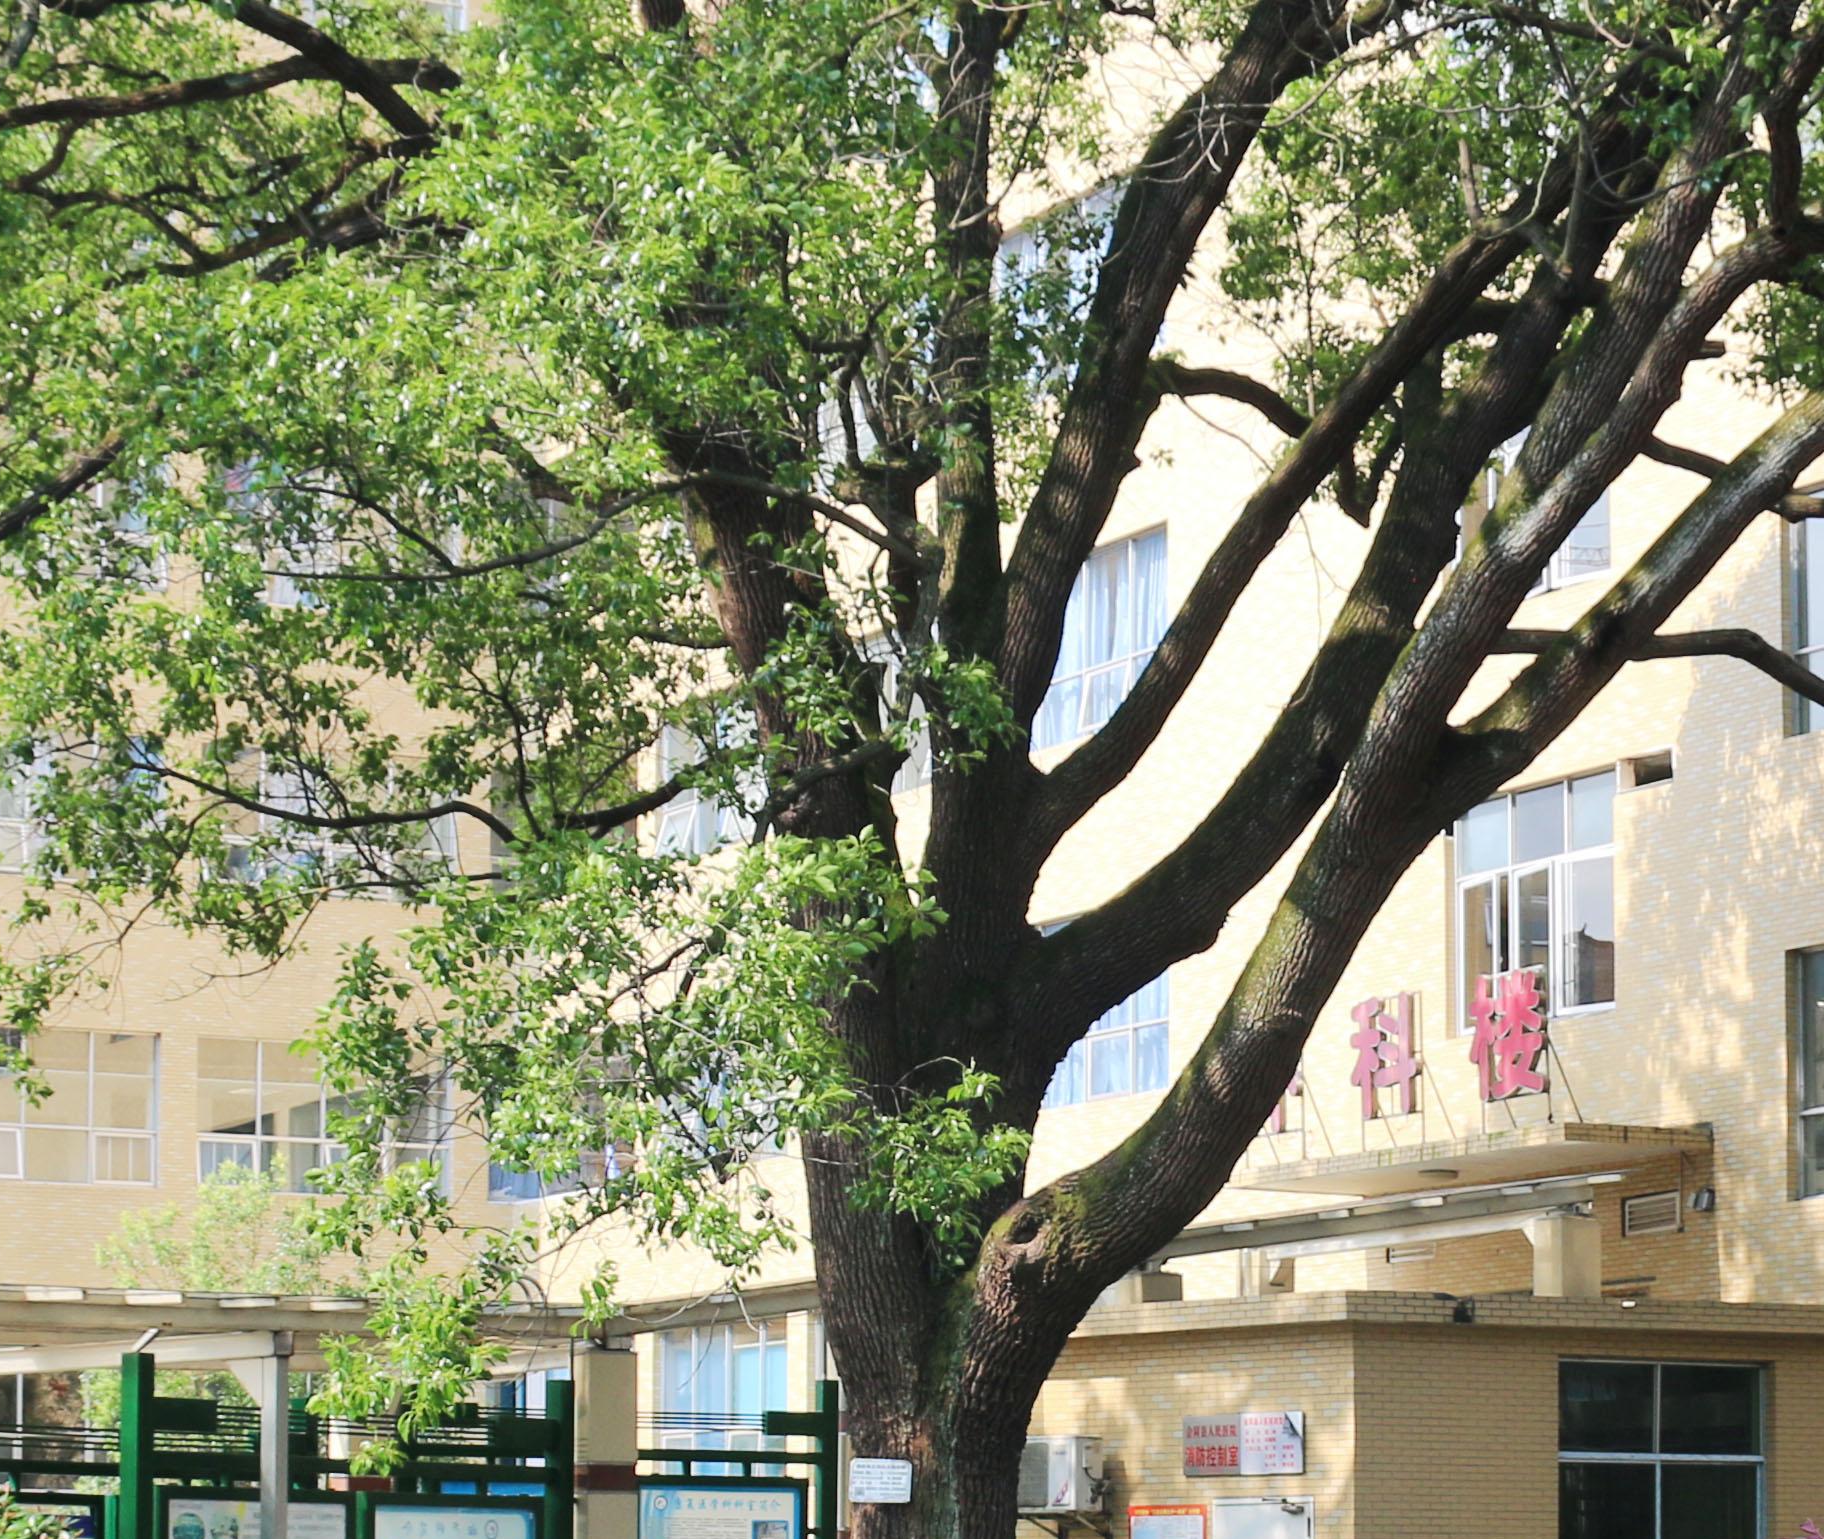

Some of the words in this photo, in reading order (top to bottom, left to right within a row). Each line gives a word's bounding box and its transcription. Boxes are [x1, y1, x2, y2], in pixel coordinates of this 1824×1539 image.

[1270, 968, 1550, 1133] 科楼
[1185, 1444, 1238, 1467] 消防控制室
